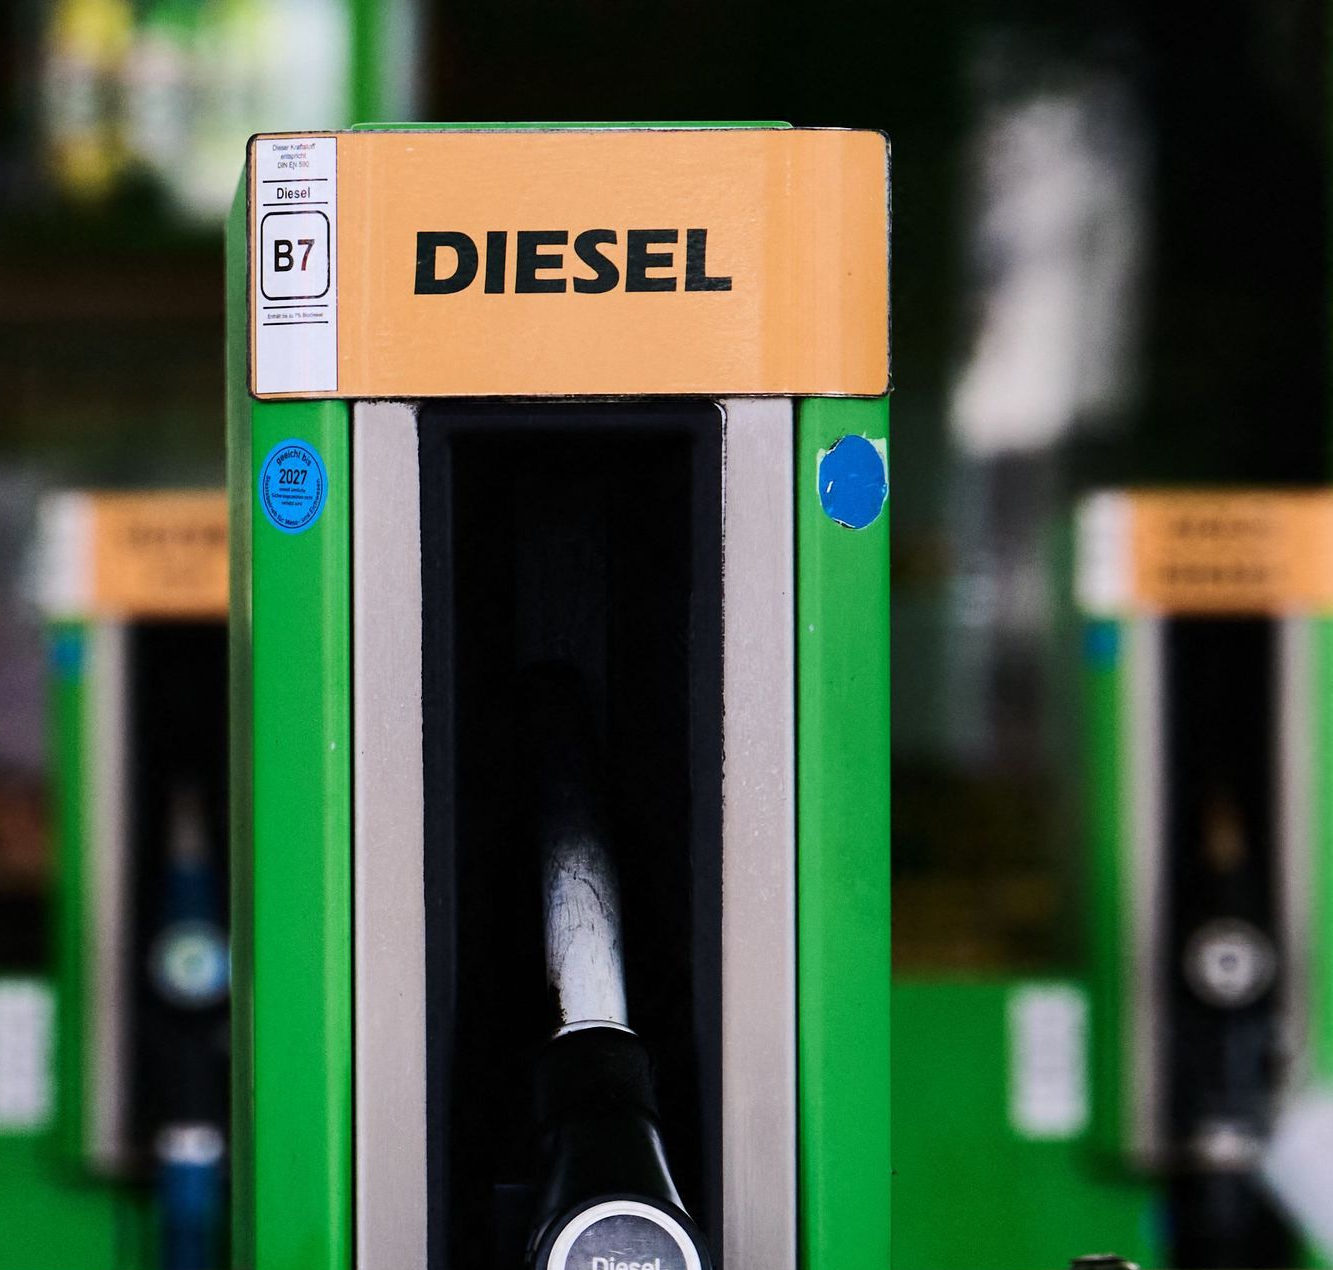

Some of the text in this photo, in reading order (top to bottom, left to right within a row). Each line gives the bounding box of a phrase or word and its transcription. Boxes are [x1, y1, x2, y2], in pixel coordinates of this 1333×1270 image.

[277, 187, 310, 199] Diesel
[274, 239, 315, 272] B7
[414, 228, 732, 295] DIESEL
[276, 449, 312, 467] geeicht bis
[279, 468, 308, 485] 2027
